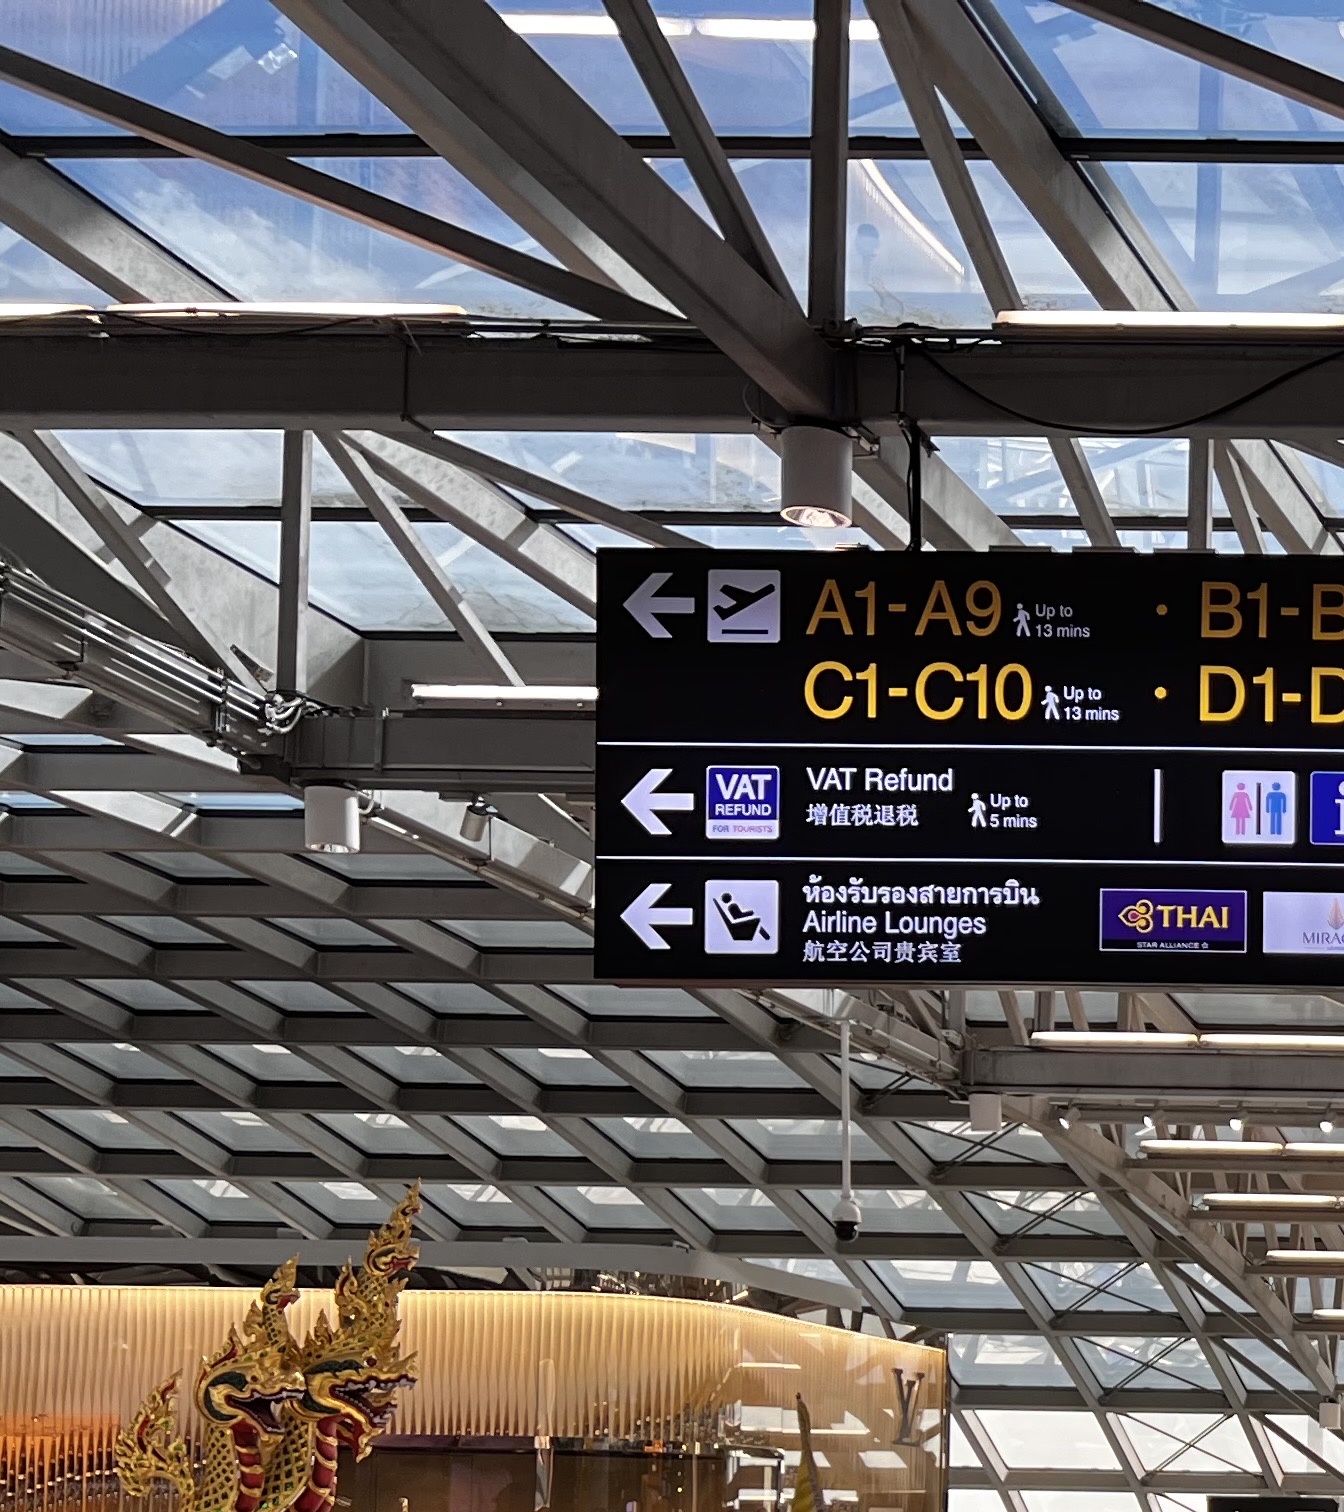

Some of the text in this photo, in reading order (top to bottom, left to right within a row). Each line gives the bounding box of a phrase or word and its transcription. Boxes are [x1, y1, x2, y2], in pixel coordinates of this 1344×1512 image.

[806, 580, 1001, 636] A1-A9
[1036, 604, 1072, 620] Up to
[1036, 624, 1090, 637] 13 mins
[805, 661, 1032, 720] C1-C10
[1063, 685, 1101, 702] Up to
[1064, 706, 1119, 720] 13 mins
[715, 774, 772, 800] VAT
[806, 767, 952, 791] VAT Refund
[715, 804, 771, 816] REFUND
[990, 794, 1028, 810] Up to
[806, 803, 918, 826] 增值税退税
[990, 814, 1037, 828] 5 mins
[711, 824, 773, 833] FOR TOURISTS
[802, 874, 1040, 905] ห้องรับรองสายการบิน
[803, 910, 986, 939] Airline Lounges
[1156, 904, 1230, 929] THAI
[803, 940, 961, 963] 航空公司贵宾室
[1136, 941, 1200, 950] STAR ALLIANCE
